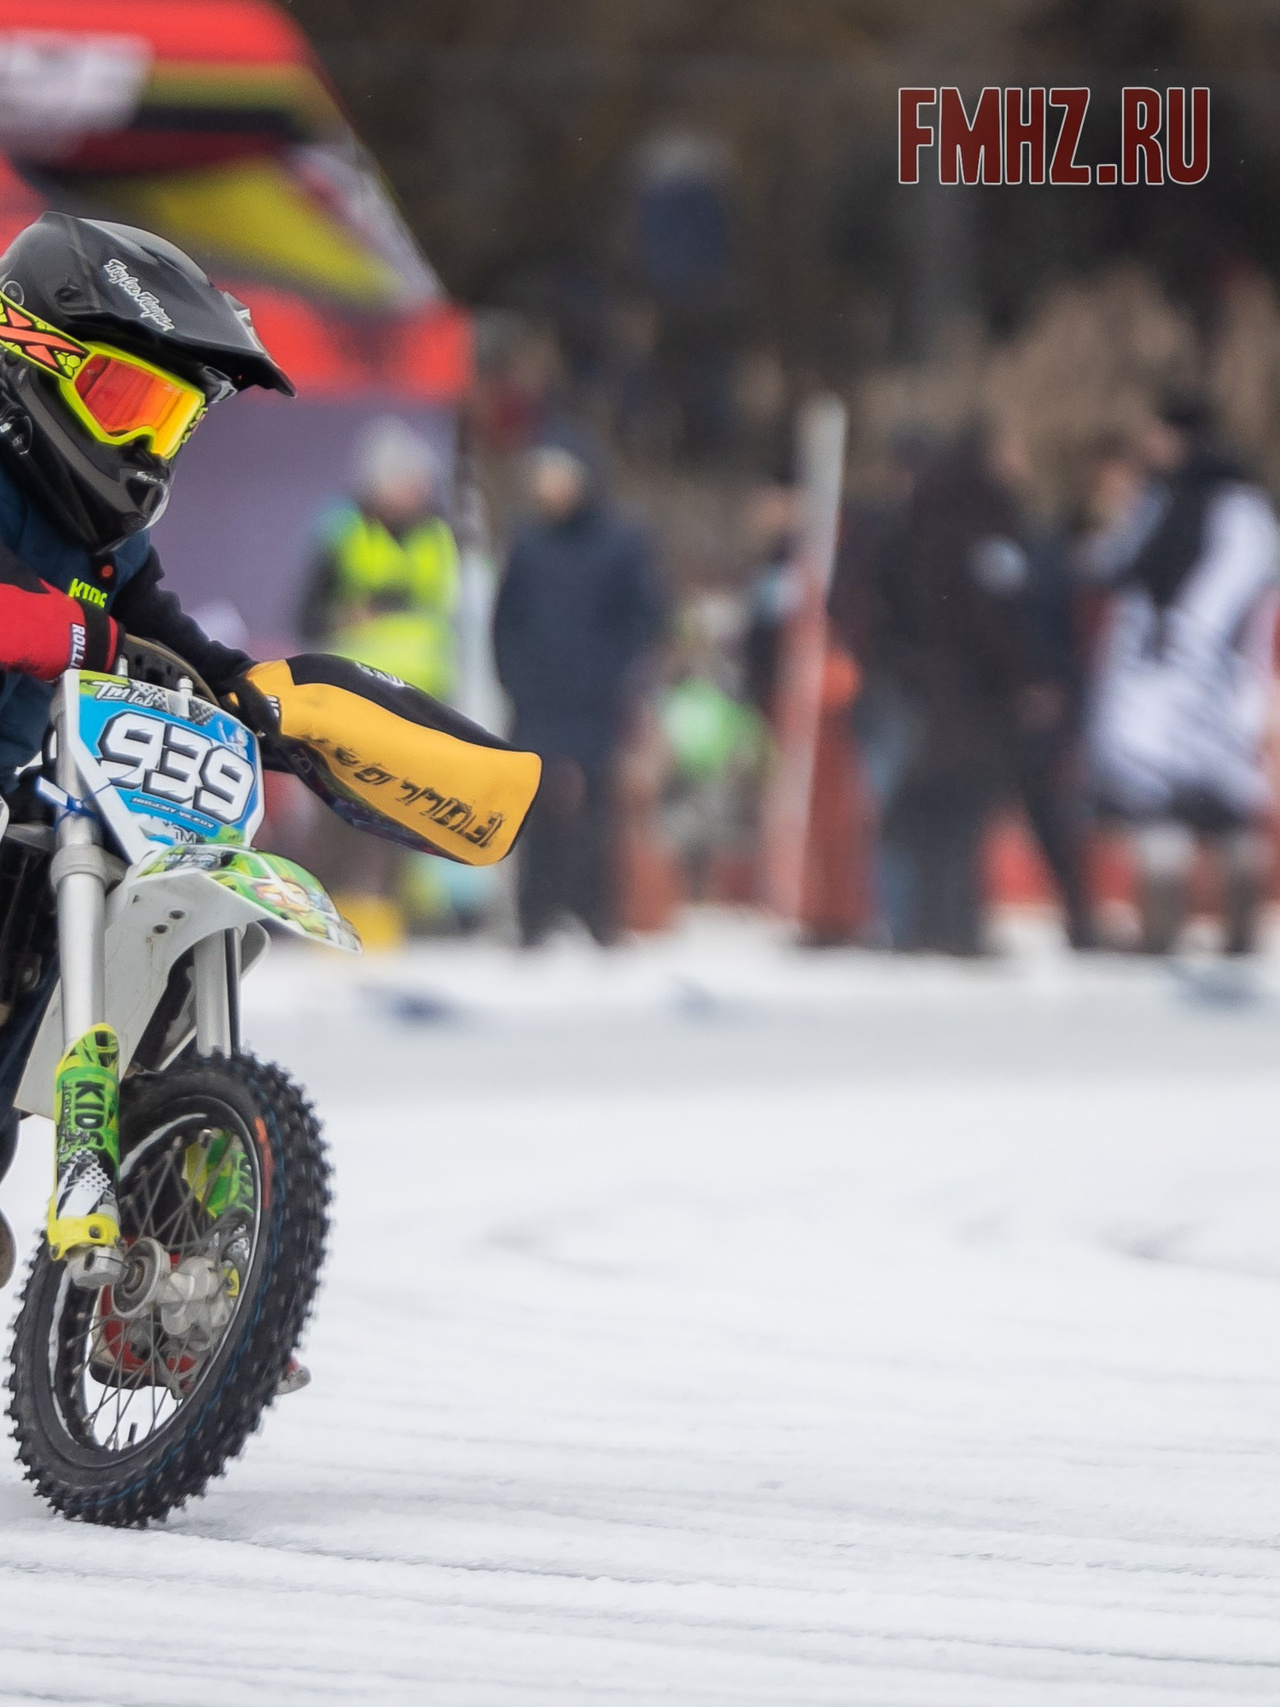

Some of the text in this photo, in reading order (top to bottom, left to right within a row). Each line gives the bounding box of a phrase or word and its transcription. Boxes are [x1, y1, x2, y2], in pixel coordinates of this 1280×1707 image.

[70, 623, 86, 669] ROLLI
[96, 710, 256, 825] 939
[396, 777, 503, 848] FULL
